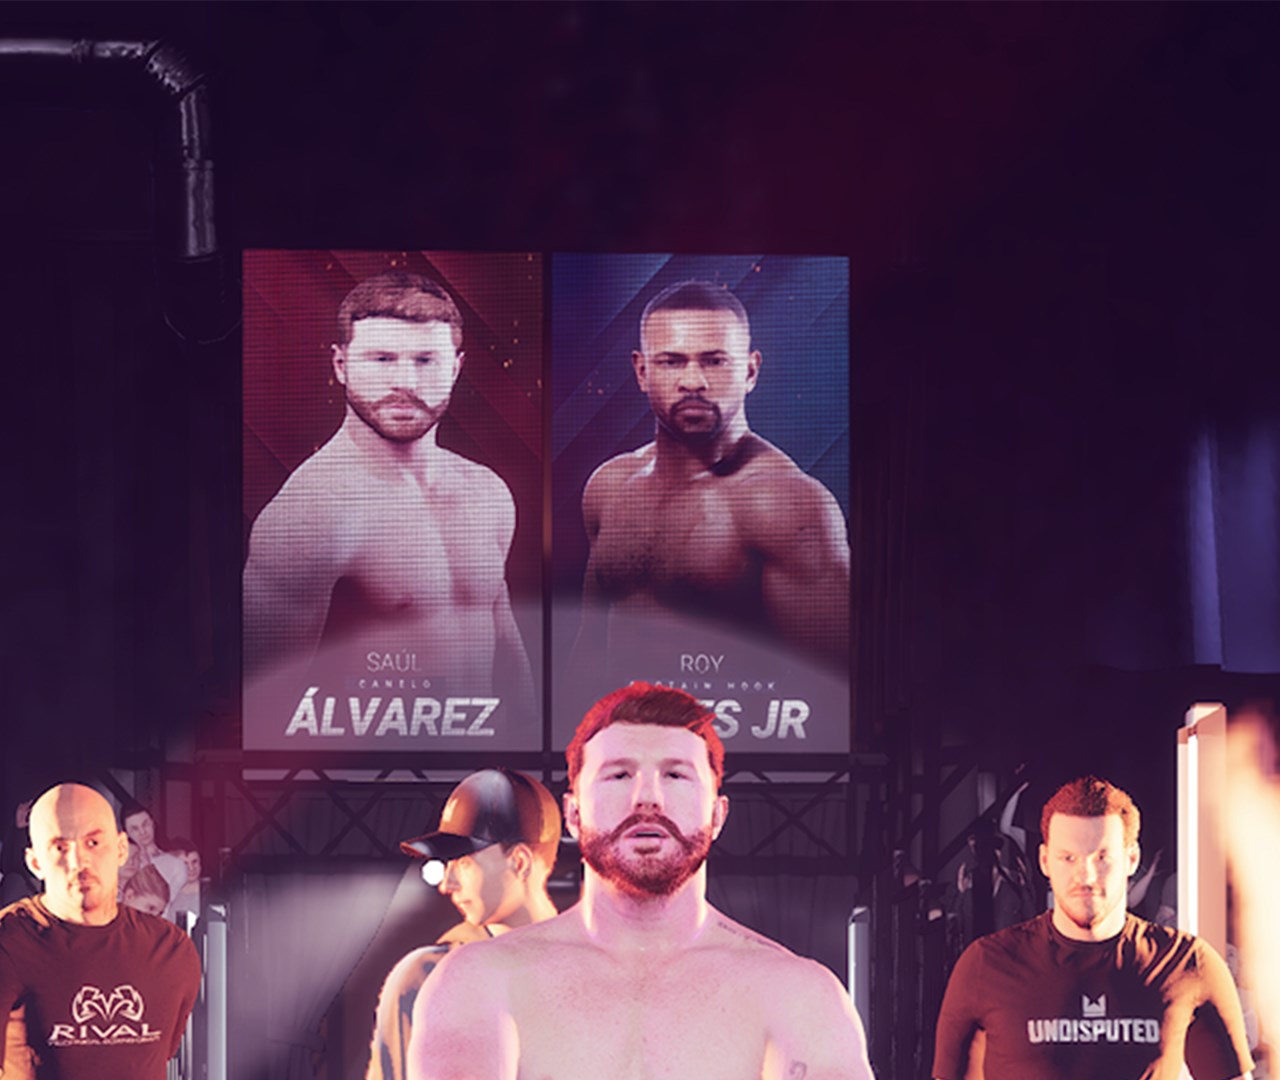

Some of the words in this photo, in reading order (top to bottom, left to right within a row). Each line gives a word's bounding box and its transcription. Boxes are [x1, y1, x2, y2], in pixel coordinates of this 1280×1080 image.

[367, 649, 422, 672] SAÚL
[680, 654, 724, 674] ROY
[358, 679, 431, 689] CANELO
[727, 682, 776, 691] HOOK
[284, 687, 500, 736] ÁLVAREZ
[751, 700, 810, 739] JR
[48, 1024, 162, 1041] RIVAL
[1027, 1019, 1160, 1043] UNDISPUTED
